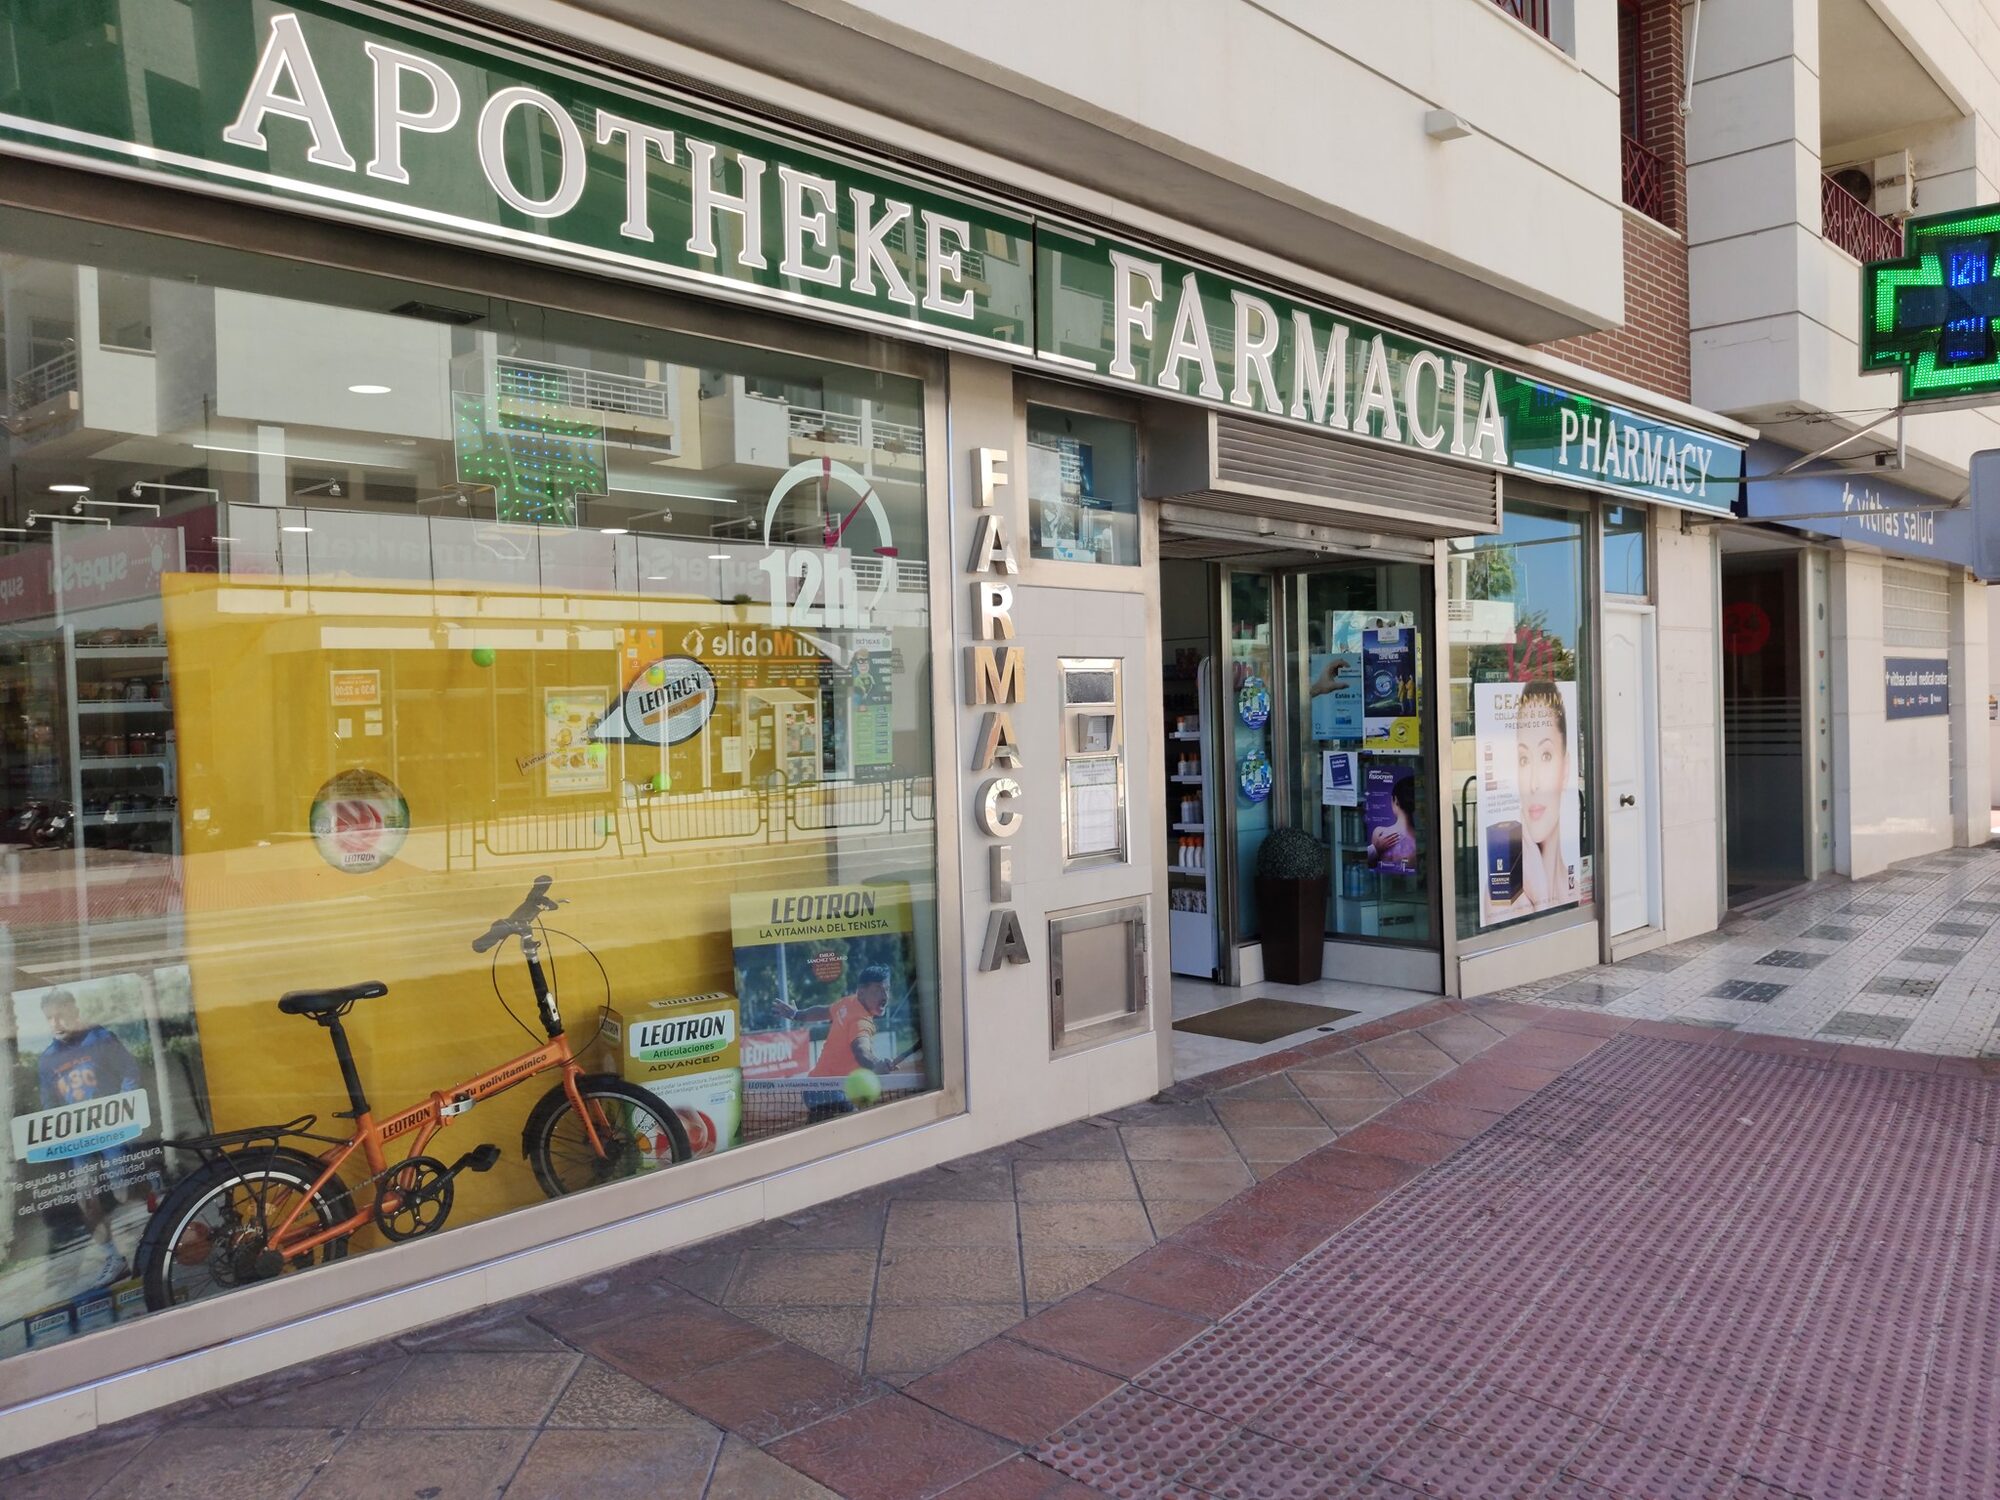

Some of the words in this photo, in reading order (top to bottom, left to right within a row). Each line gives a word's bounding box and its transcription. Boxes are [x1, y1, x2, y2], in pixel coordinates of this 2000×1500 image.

[223, 12, 975, 320] APOTHEKE
[1109, 249, 1509, 466] FARMACIA
[1557, 406, 1713, 498] PHARMACY
[1857, 488, 1899, 537] vithas
[1903, 504, 1934, 545] salud
[759, 549, 859, 629] 12h
[1504, 626, 1555, 682] 12h
[638, 671, 702, 715] LEOTRON
[964, 446, 1032, 972] FARMACIA
[760, 929, 772, 939] LA
[773, 925, 825, 937] VITAMINA
[827, 923, 847, 934] DEL
[848, 919, 889, 932] TENISTA
[770, 890, 876, 925] LEOTRON
[640, 1015, 726, 1048] LEOTRON
[653, 1042, 715, 1059] Articulaciones
[741, 1039, 793, 1066] LEOTRON
[648, 1055, 721, 1073] ADVANCED
[464, 1088, 477, 1097] Tu
[27, 1095, 136, 1146] LEOTRON
[382, 1107, 431, 1139] LEOTRON
[46, 1129, 126, 1158] Articulaciones
[11, 1182, 23, 1193] Te
[26, 1172, 58, 1191] ayuda
[67, 1161, 98, 1177] cuidar
[101, 1159, 110, 1169] la
[112, 1146, 163, 1167] estructura,
[32, 1175, 90, 1200] flexibilidad
[99, 1161, 146, 1181] movilidad
[18, 1202, 35, 1216] del
[94, 1170, 161, 1195] articulaciones
